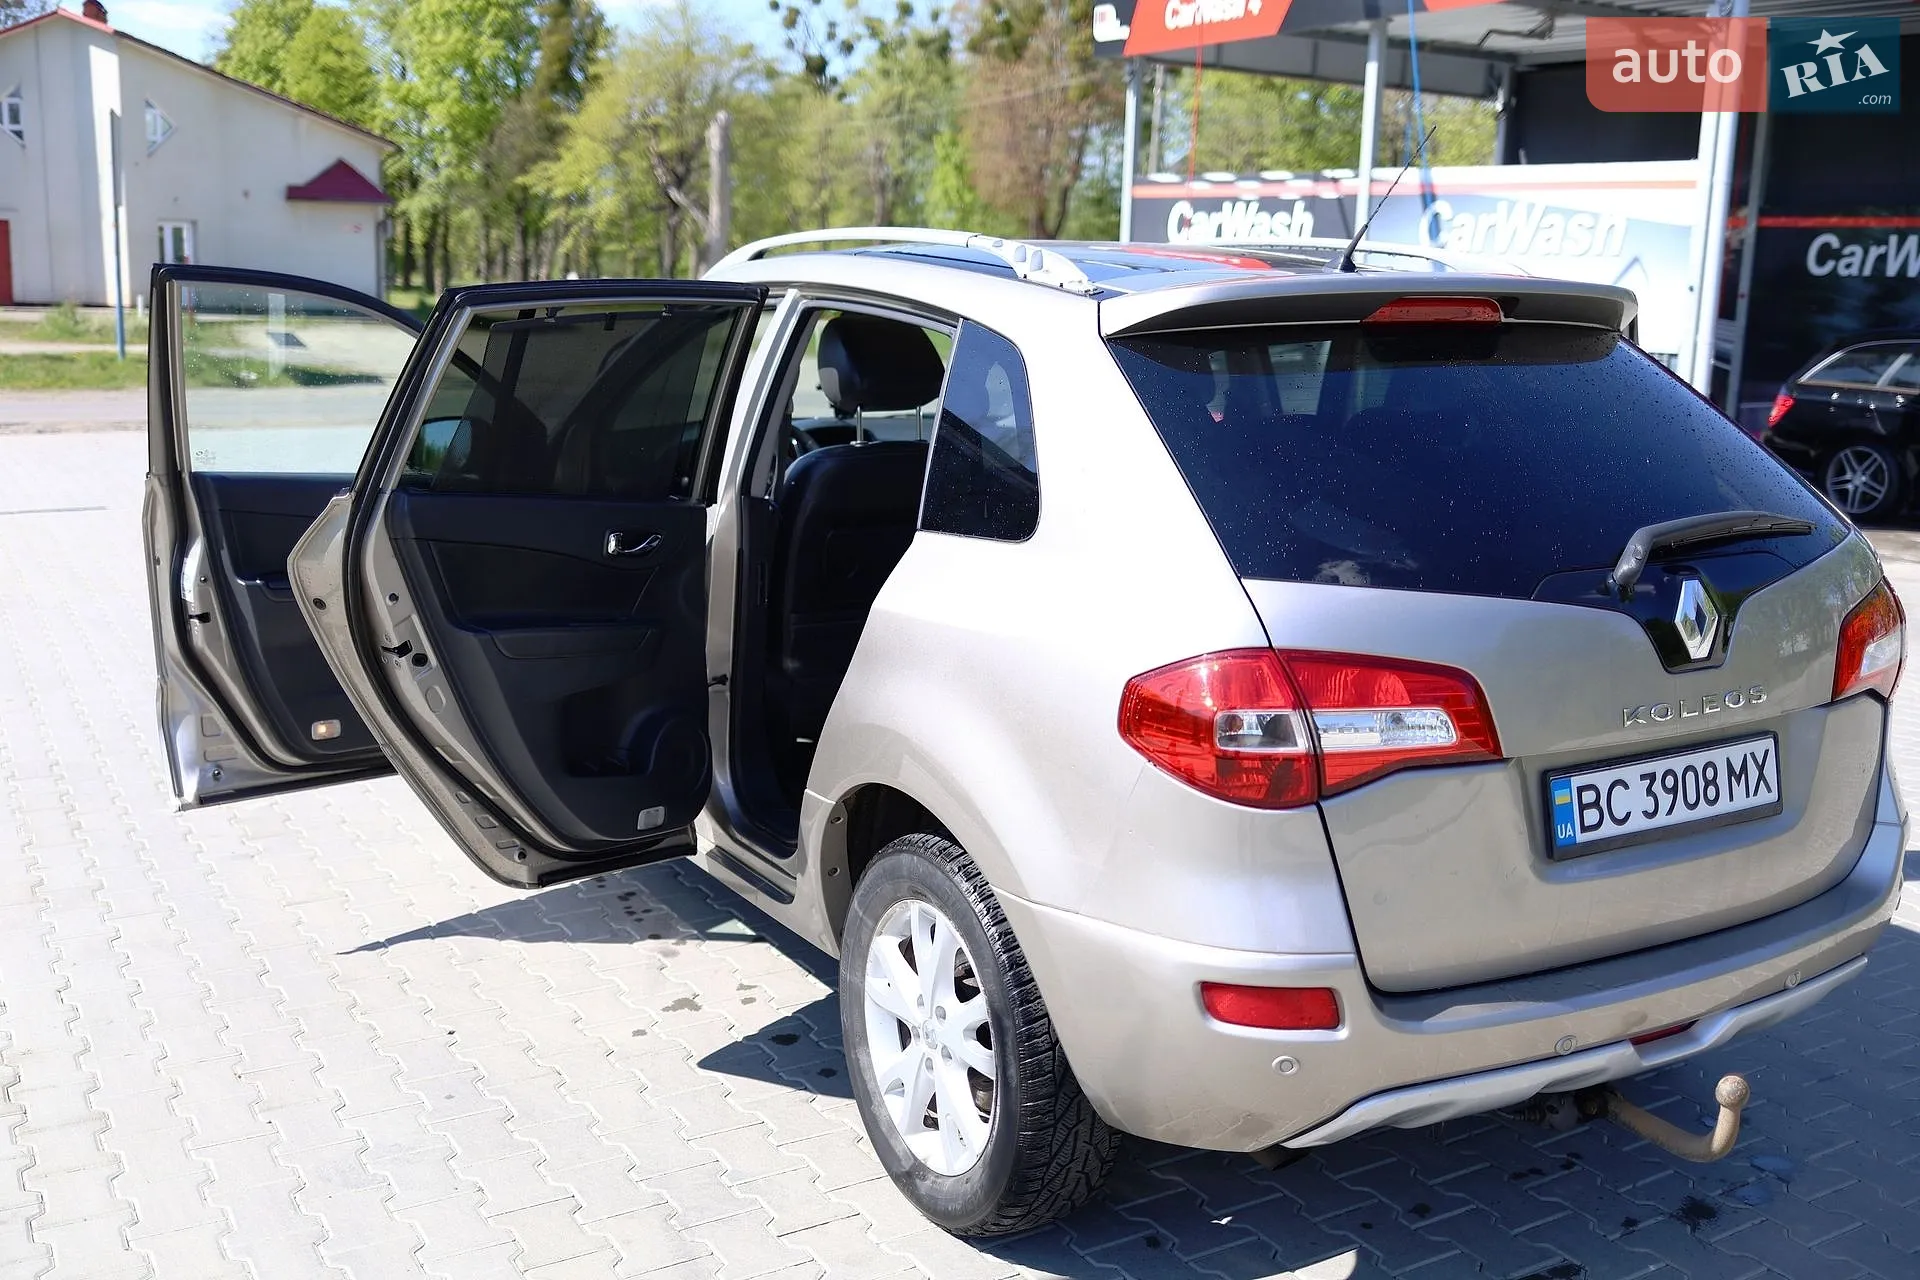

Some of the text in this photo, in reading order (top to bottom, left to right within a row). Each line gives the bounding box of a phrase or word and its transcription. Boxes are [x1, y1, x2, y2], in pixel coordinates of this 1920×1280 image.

[1167, 200, 1314, 243] CarWash
[1419, 200, 1627, 258] CarWash
[1622, 685, 1768, 728] KOLEOS
[1576, 749, 1773, 834] BC 3908 MX
[1557, 824, 1574, 840] UA
